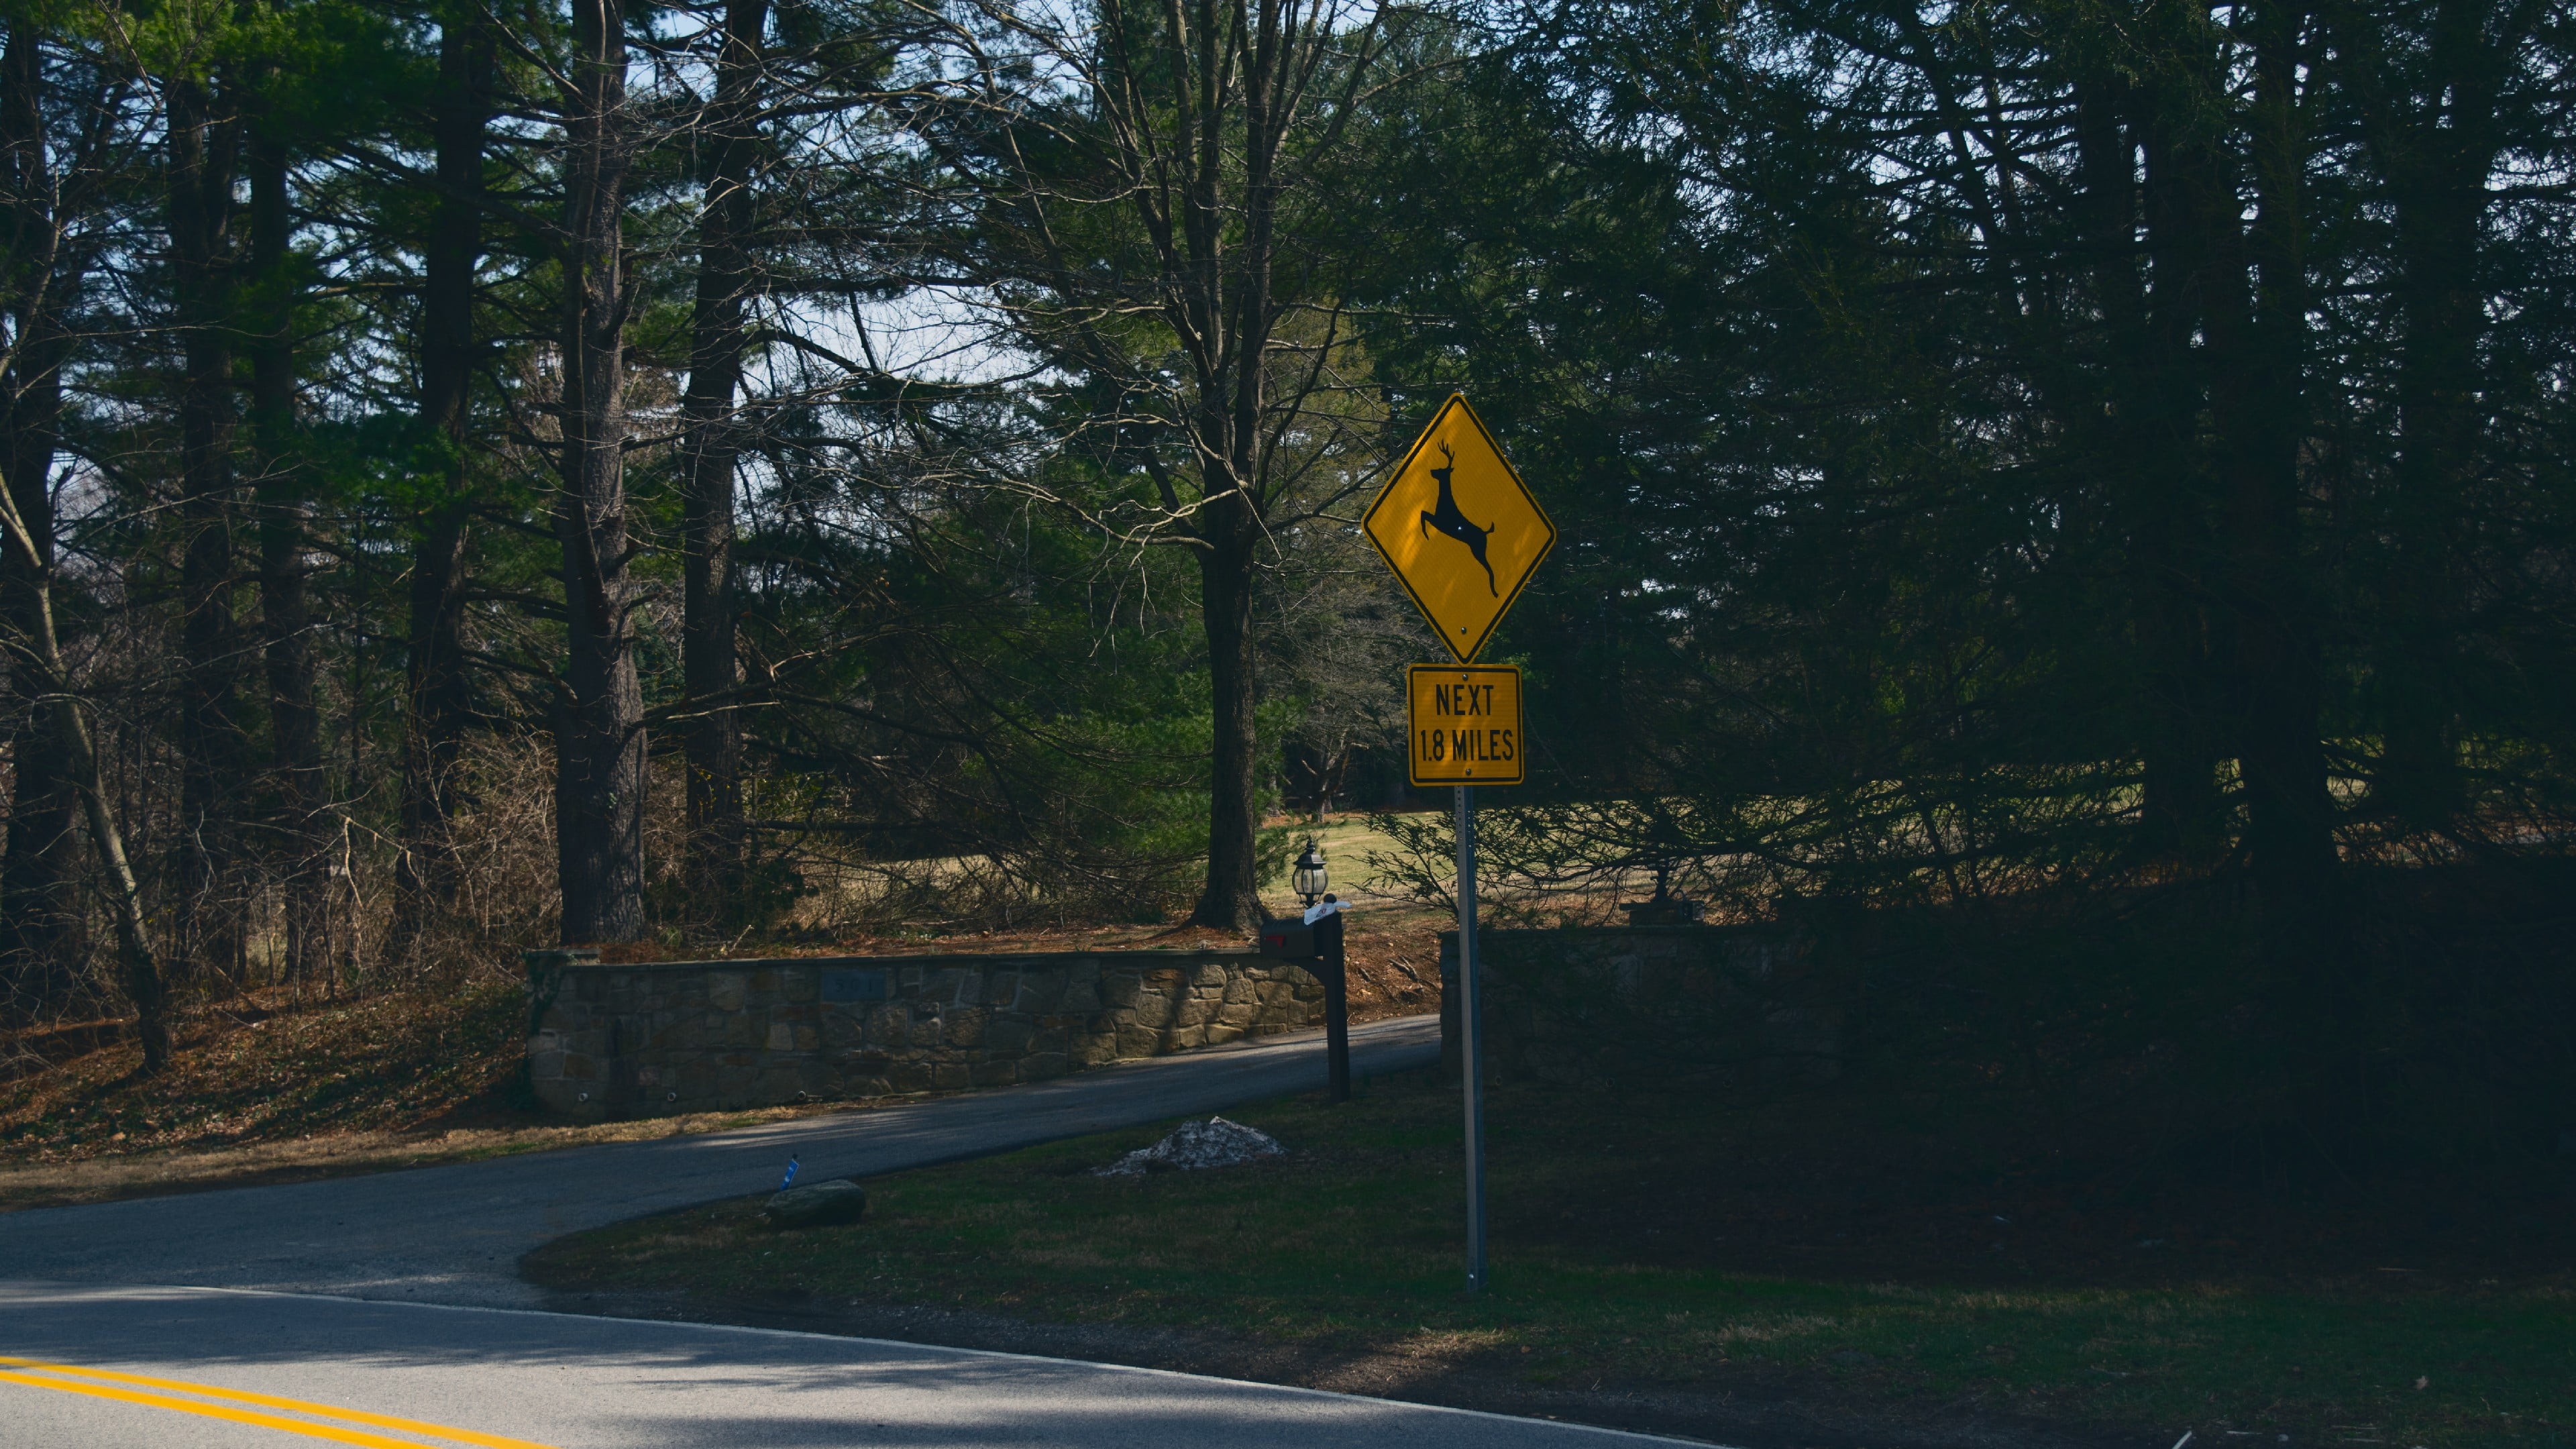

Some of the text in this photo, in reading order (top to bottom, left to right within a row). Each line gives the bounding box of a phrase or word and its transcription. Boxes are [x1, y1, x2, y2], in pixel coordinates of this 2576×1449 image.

[1436, 684, 1494, 716] NEXT
[1421, 729, 1513, 761] 1.8 MILES
